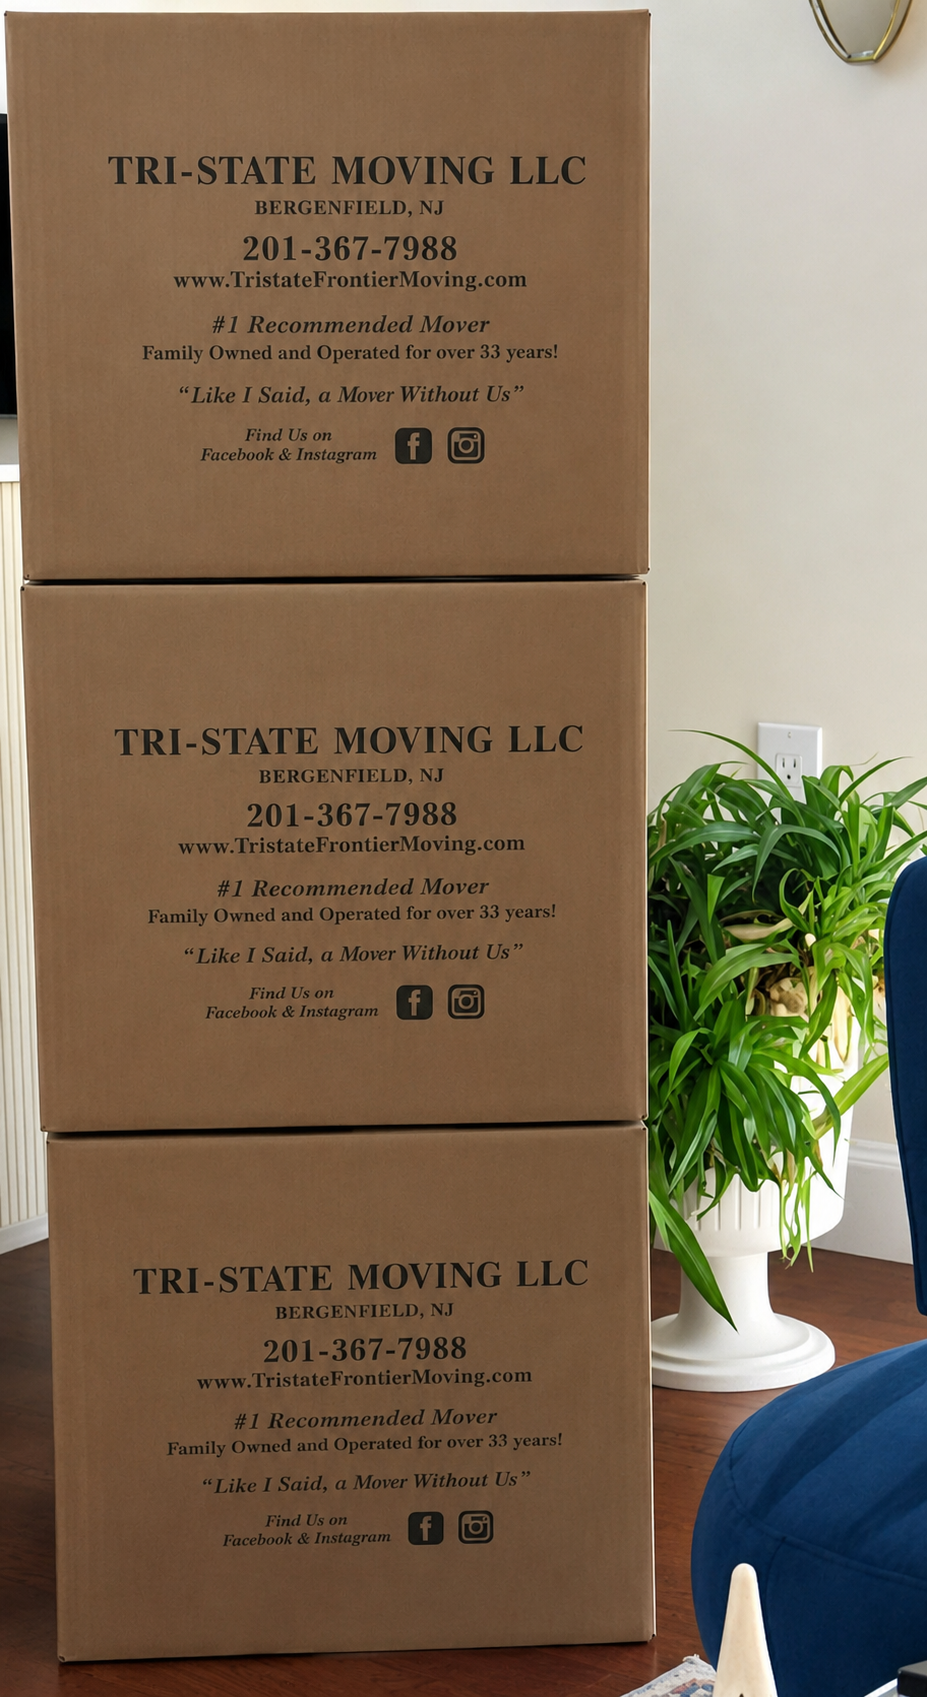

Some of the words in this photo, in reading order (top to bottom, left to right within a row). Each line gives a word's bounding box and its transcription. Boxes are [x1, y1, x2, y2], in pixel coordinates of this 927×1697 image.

[108, 156, 315, 185] TRI-STATE
[332, 156, 494, 184] MOVING
[510, 156, 585, 185] LLC
[255, 200, 412, 217] BERGENFIELD,
[420, 200, 444, 215] NJ
[243, 236, 456, 261] 201-367-7988
[174, 271, 527, 292] www.TristateFrontierMoving.com
[212, 316, 238, 333] #1
[247, 315, 413, 333] Recommended
[419, 315, 490, 333] Mover
[142, 345, 203, 364] Family
[209, 345, 272, 360] Owned
[278, 345, 311, 359] and
[317, 345, 400, 364] Operated
[406, 344, 431, 359] for
[437, 349, 475, 359] over
[480, 344, 500, 359] 33
[506, 344, 557, 363] years!
[180, 386, 236, 403] “Like
[242, 387, 252, 403] I
[258, 386, 310, 406] Said,
[319, 391, 331, 403] a
[337, 386, 394, 402] Mover
[400, 386, 479, 402] Without
[487, 385, 524, 402] Us”
[245, 428, 283, 441] Find
[289, 428, 307, 441] Us
[313, 432, 332, 441] on
[200, 448, 274, 461] Facebook
[279, 448, 292, 461] &
[296, 448, 377, 464] Instagram
[115, 728, 318, 756] TRI-STATE
[334, 726, 492, 754] MOVING
[509, 725, 582, 752] LLC
[259, 769, 412, 785] BERGENFIELD,
[420, 768, 444, 782] NJ
[248, 802, 456, 827] 201-367-7988
[178, 835, 525, 855] www.TristateFrontierMoving.com
[218, 880, 242, 897] #1
[252, 878, 414, 897] Recommended
[420, 878, 489, 895] Mover
[148, 909, 208, 927] Family
[214, 908, 275, 922] Owned
[282, 907, 313, 921] and
[320, 906, 401, 925] Operated
[407, 906, 431, 920] for
[437, 909, 474, 919] over
[480, 905, 499, 919] 33
[505, 904, 555, 922] years!
[185, 948, 240, 964] “Like
[246, 948, 256, 963] I
[262, 946, 312, 964] Said,
[321, 951, 333, 962] a
[340, 946, 396, 961] Mover
[403, 945, 479, 960] Without
[487, 943, 523, 959] Us”
[249, 987, 286, 999] Find
[292, 987, 310, 999] Us
[315, 990, 333, 998] on
[206, 1005, 277, 1019] Facebook
[282, 1005, 295, 1018] &
[299, 1005, 378, 1021] Instagram
[133, 1265, 332, 1294] TRI-STATE
[348, 1261, 501, 1290] MOVING
[517, 1260, 588, 1286] LLC
[276, 1304, 424, 1319] BERGENFIELD,
[431, 1303, 453, 1316] NJ
[264, 1337, 466, 1362] 201-367-7988
[197, 1369, 532, 1389] www.TristateFrontierMoving.com
[235, 1413, 258, 1429] #1
[268, 1409, 425, 1429] Recommended
[431, 1409, 497, 1425] Mover
[167, 1441, 226, 1458] Family
[232, 1439, 291, 1453] Owned
[297, 1438, 328, 1451] and
[334, 1436, 412, 1454] Operated
[418, 1436, 442, 1449] for
[447, 1439, 483, 1448] over
[489, 1434, 507, 1447] 33
[513, 1433, 562, 1450] years!
[203, 1478, 256, 1493] “Like
[263, 1478, 272, 1492] I
[278, 1475, 327, 1493] Said,
[335, 1480, 346, 1490] a
[353, 1475, 408, 1489] Mover
[414, 1473, 488, 1488] Without
[496, 1471, 530, 1486] Us”
[265, 1514, 301, 1527] Find
[307, 1514, 324, 1526] Us
[329, 1517, 347, 1525] on
[223, 1533, 292, 1546] Facebook
[298, 1533, 309, 1544] &
[315, 1532, 390, 1546] Instagram
